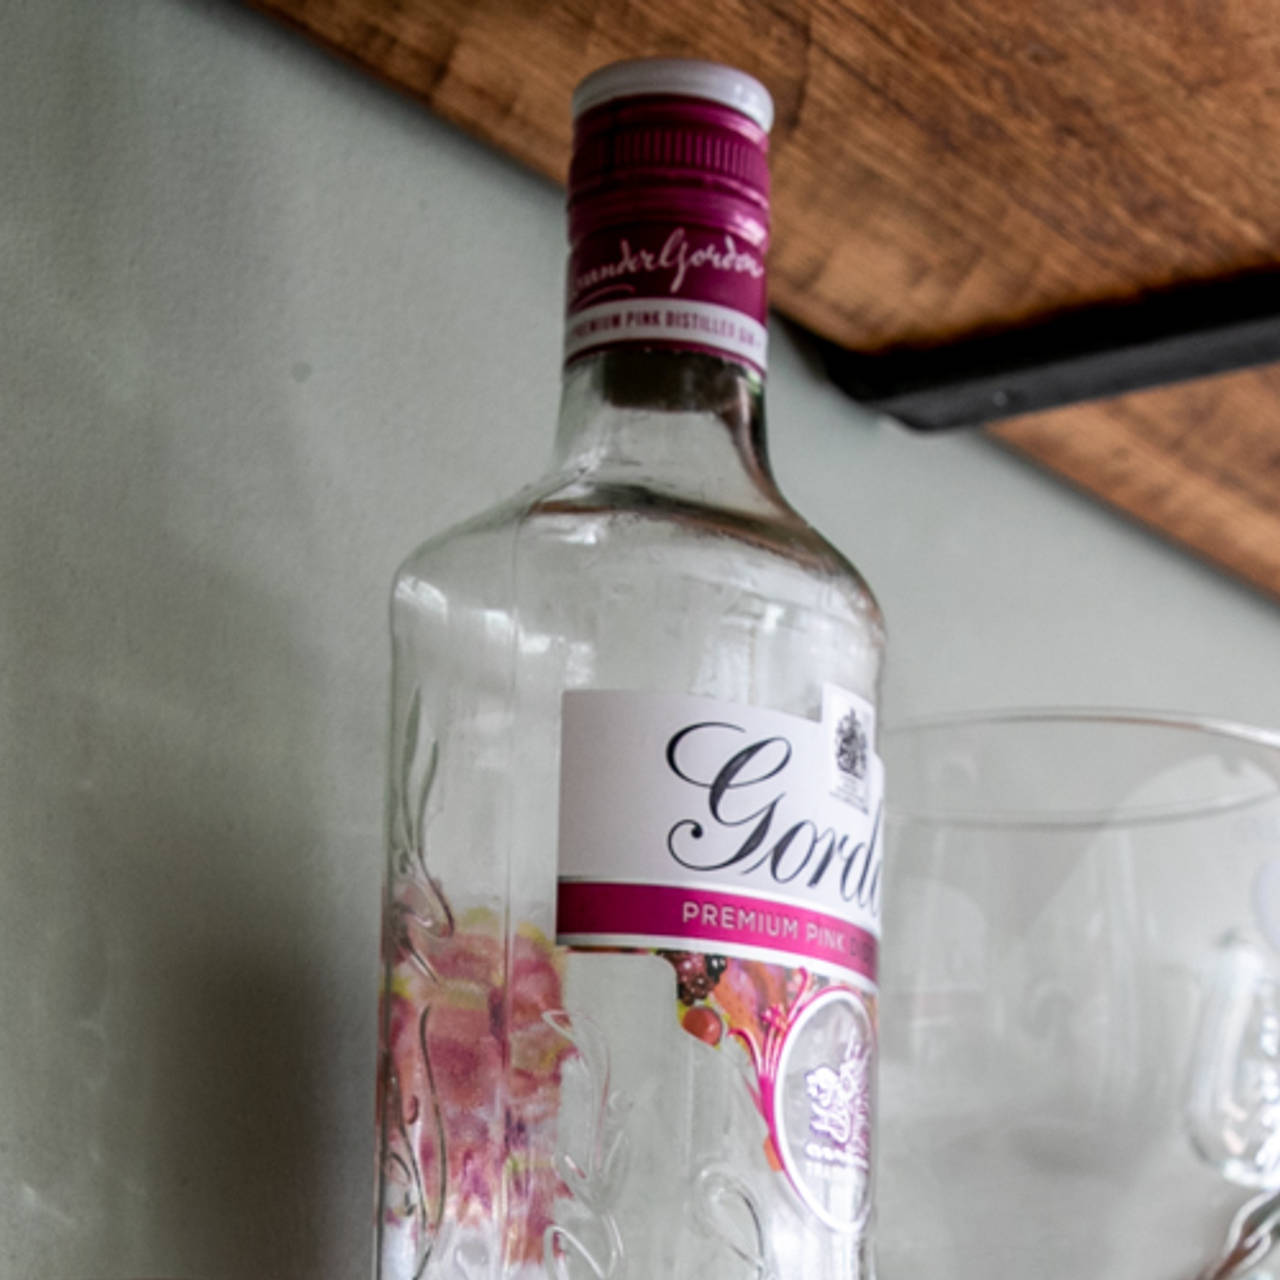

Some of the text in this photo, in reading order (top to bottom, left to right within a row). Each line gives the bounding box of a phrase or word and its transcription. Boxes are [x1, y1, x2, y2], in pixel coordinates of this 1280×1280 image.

[625, 310, 661, 328] PINK
[681, 900, 799, 939] PREMIUM
[805, 921, 846, 955] PINK
